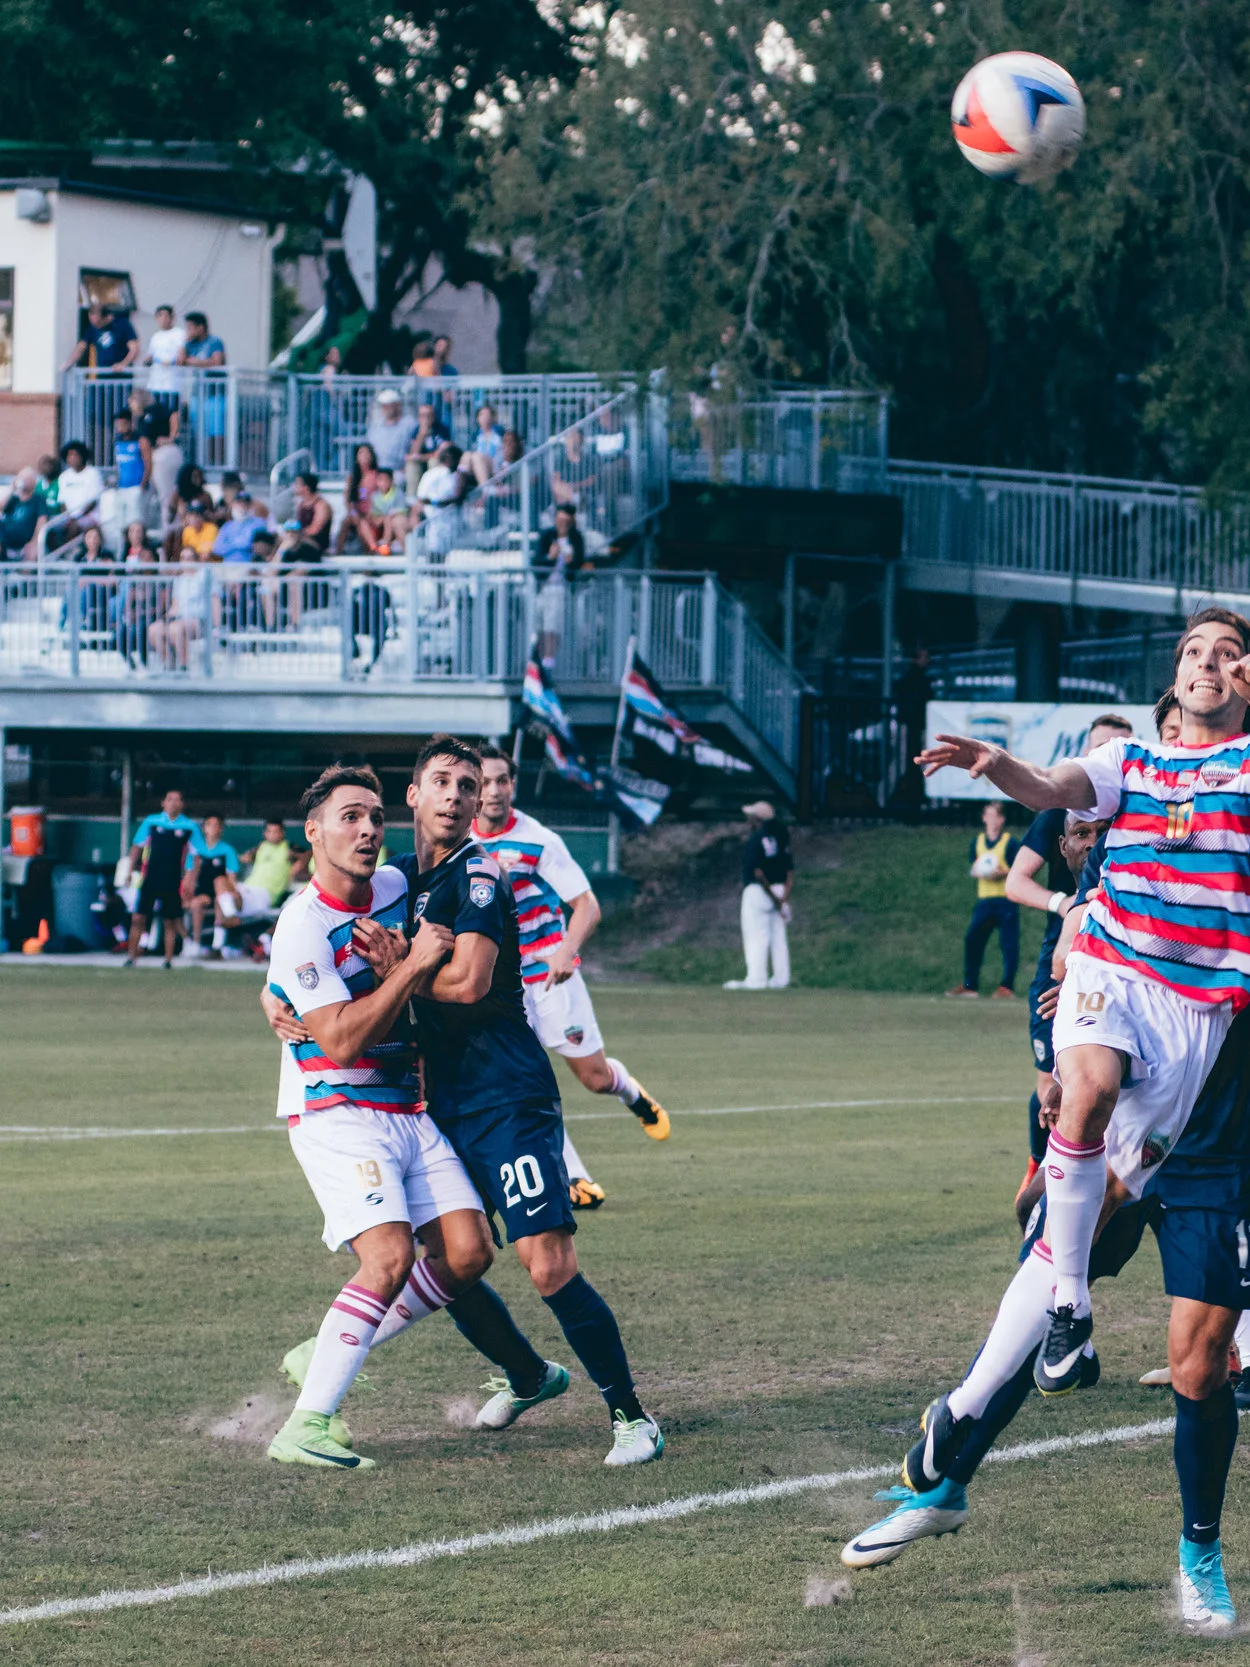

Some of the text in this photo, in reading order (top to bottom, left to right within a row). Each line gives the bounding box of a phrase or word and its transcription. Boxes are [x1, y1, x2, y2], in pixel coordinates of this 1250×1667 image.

[1048, 729, 1089, 767] M
[1165, 802, 1194, 839] 10
[1076, 991, 1106, 1014] 10
[355, 1159, 383, 1190] 19
[500, 1154, 545, 1209] 20
